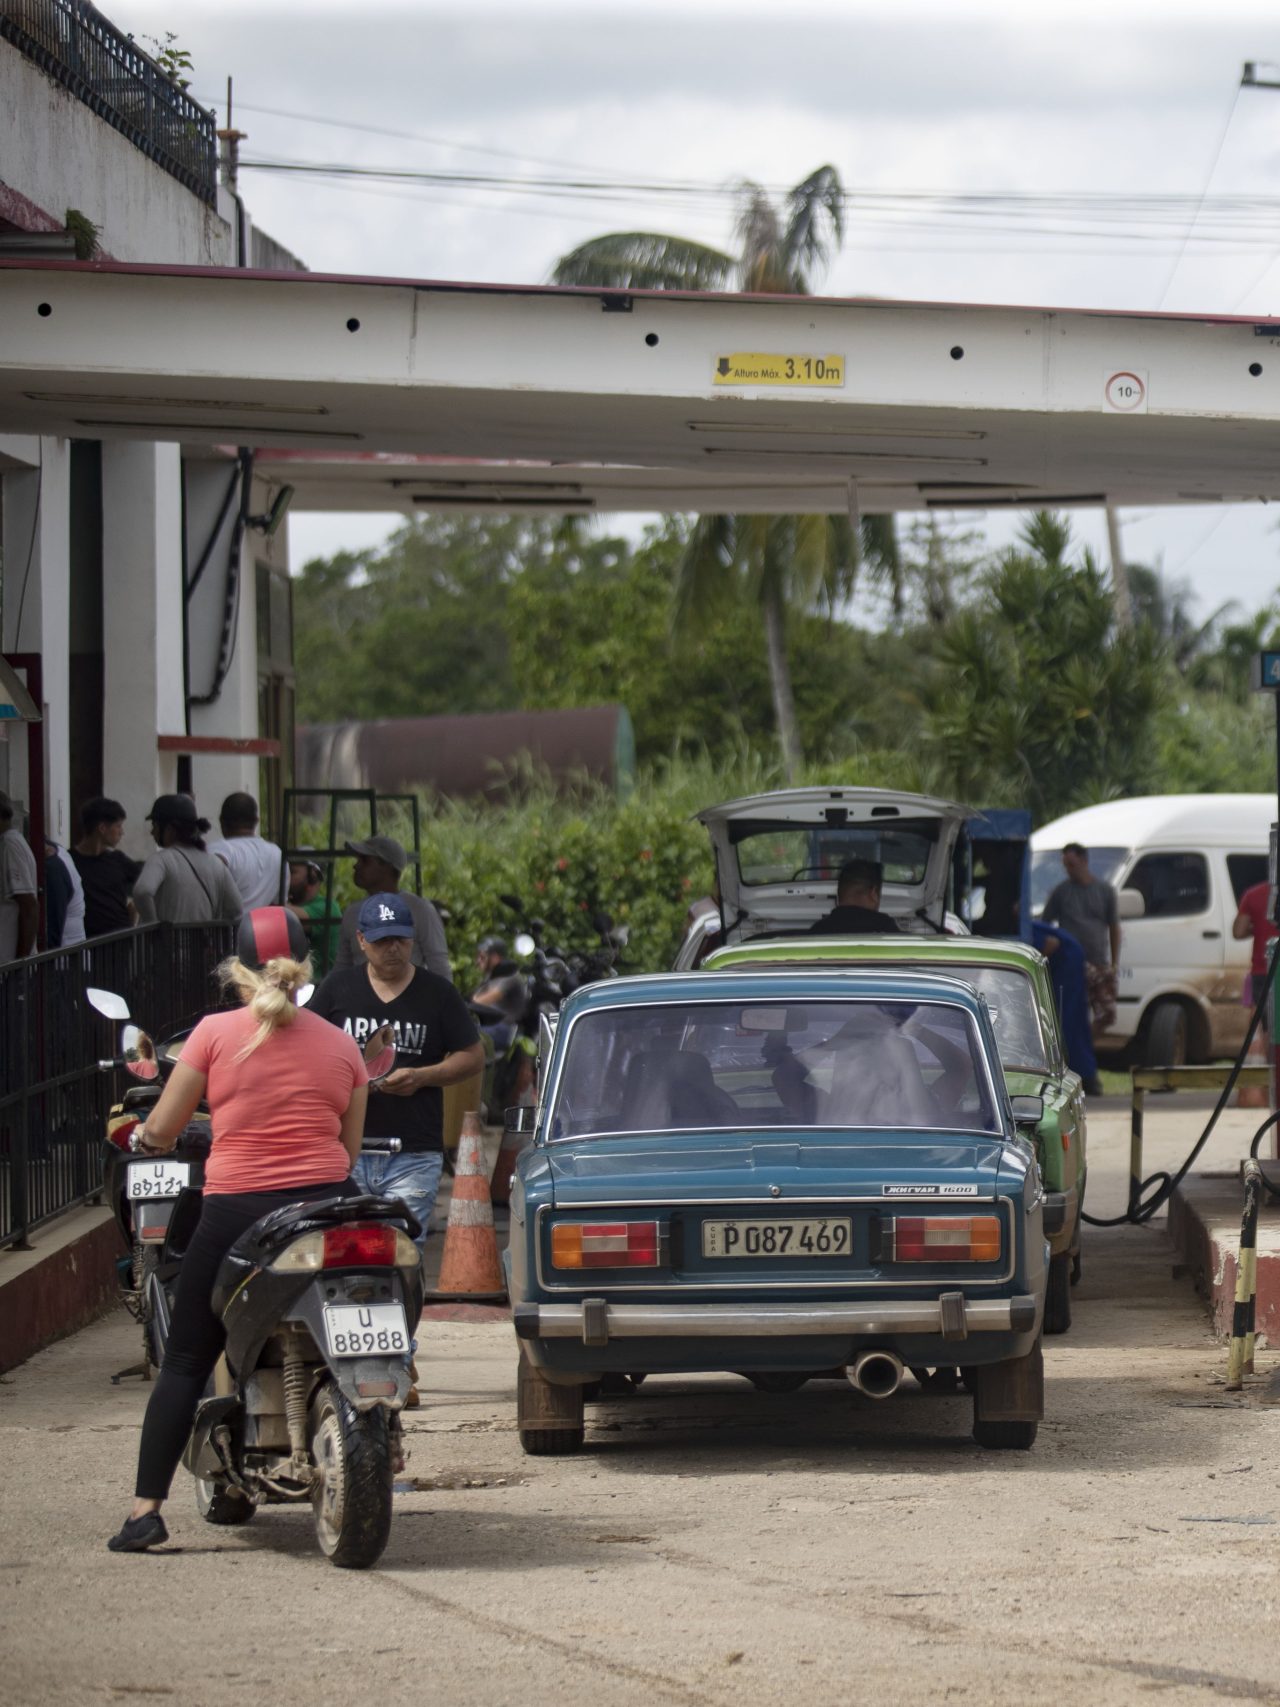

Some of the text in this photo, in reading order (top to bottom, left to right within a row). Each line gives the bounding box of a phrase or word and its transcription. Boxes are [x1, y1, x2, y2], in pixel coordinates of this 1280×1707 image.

[734, 368, 759, 379] Altura
[785, 358, 840, 380] 3.10m
[1118, 386, 1132, 398] 10
[378, 904, 395, 921] LA
[154, 1164, 164, 1178] U
[132, 1179, 183, 1196] 89121
[724, 1224, 848, 1254] P 087 469
[358, 1308, 373, 1328] U
[335, 1331, 403, 1352] 88988
